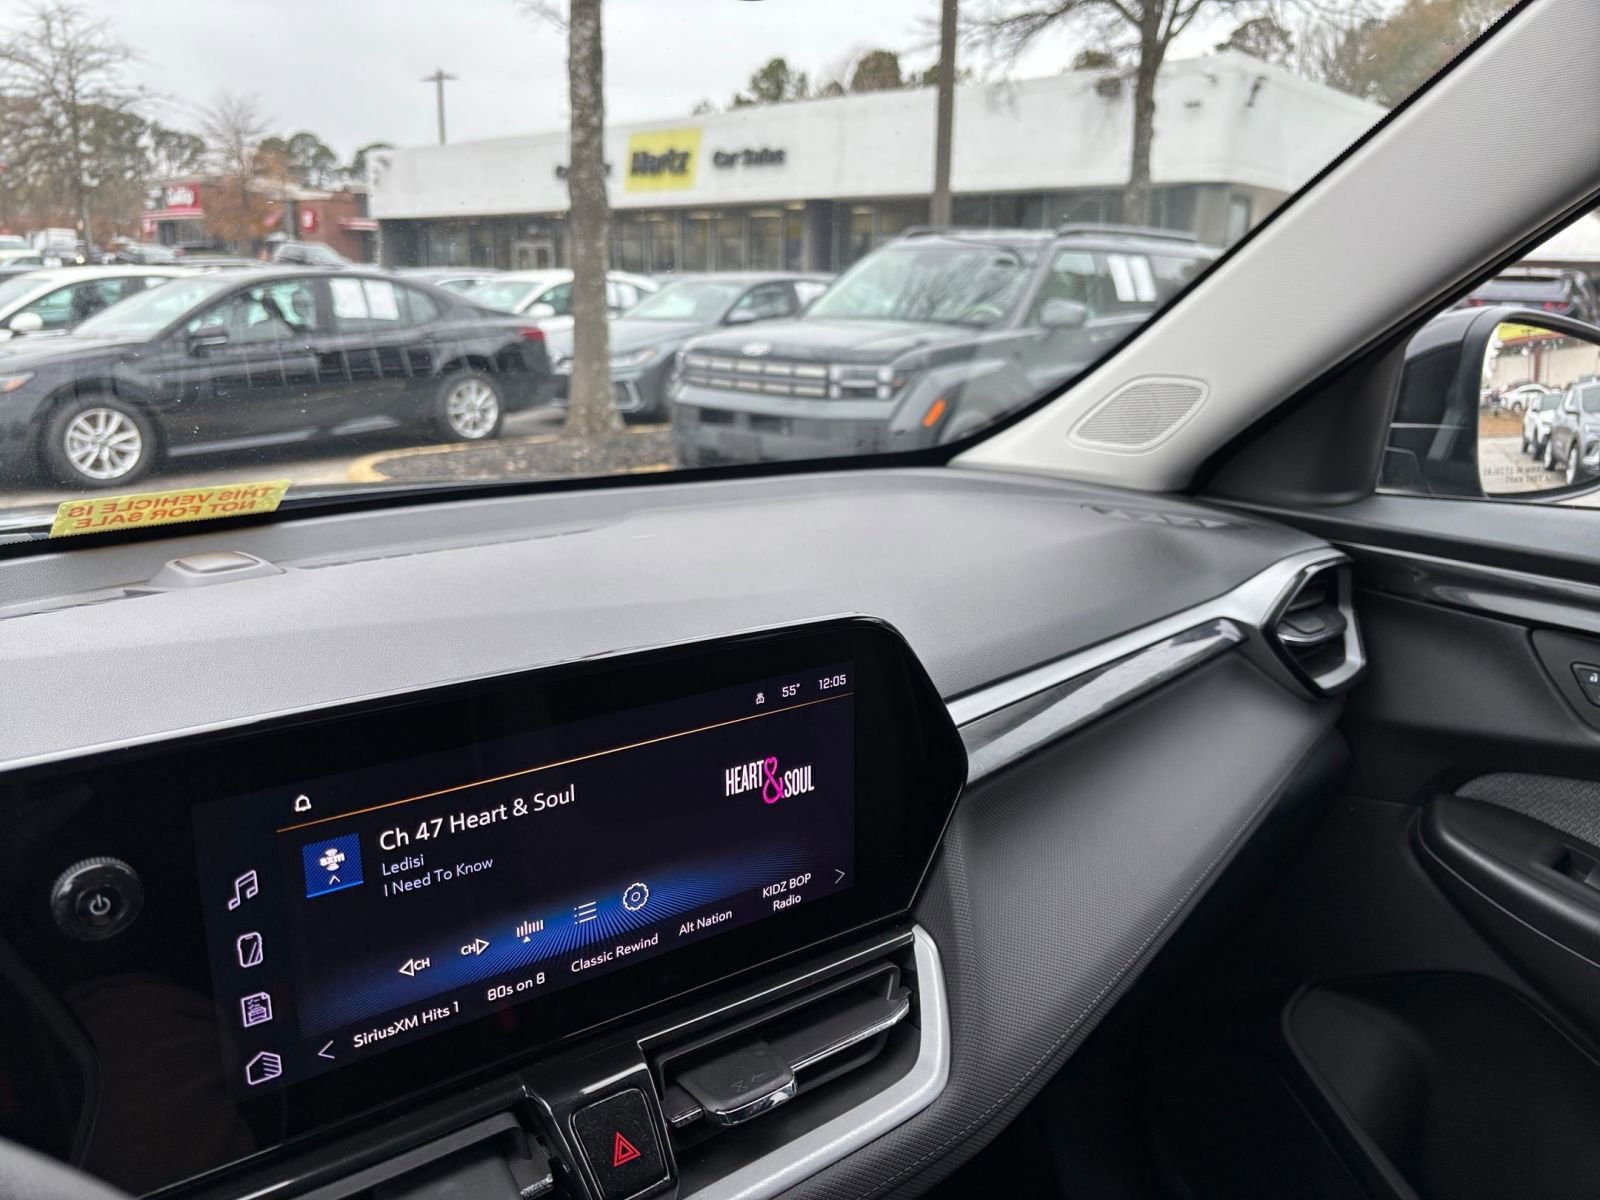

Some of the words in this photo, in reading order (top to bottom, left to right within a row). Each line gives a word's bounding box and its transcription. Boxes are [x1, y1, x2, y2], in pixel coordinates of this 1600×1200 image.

[781, 683, 801, 698] 55°
[818, 674, 847, 690] 12:05
[725, 759, 765, 797] HEART
[784, 765, 815, 798] SOUL
[379, 827, 410, 851] Ch
[415, 817, 444, 841] 47
[449, 804, 508, 834] Heart
[512, 797, 529, 817] &
[533, 783, 576, 812] Soul
[382, 855, 425, 876] Ledisi
[384, 884, 388, 897] I
[392, 871, 431, 895] Need
[433, 868, 453, 882] To
[456, 858, 494, 877] Know
[762, 880, 788, 899] KIDZ
[789, 872, 812, 889] BOP
[773, 893, 802, 912] Radio
[678, 920, 695, 936] Alt
[696, 909, 734, 930] Nation
[461, 943, 476, 955] CH
[570, 949, 615, 973] Classic
[615, 932, 659, 958] Rewind
[413, 957, 431, 971] CH
[487, 985, 514, 1001] 80s
[516, 979, 533, 992] on
[536, 971, 546, 985] 8
[352, 1014, 420, 1048] SiriusXM
[422, 1006, 451, 1024] Hits
[453, 1000, 460, 1013] 1
